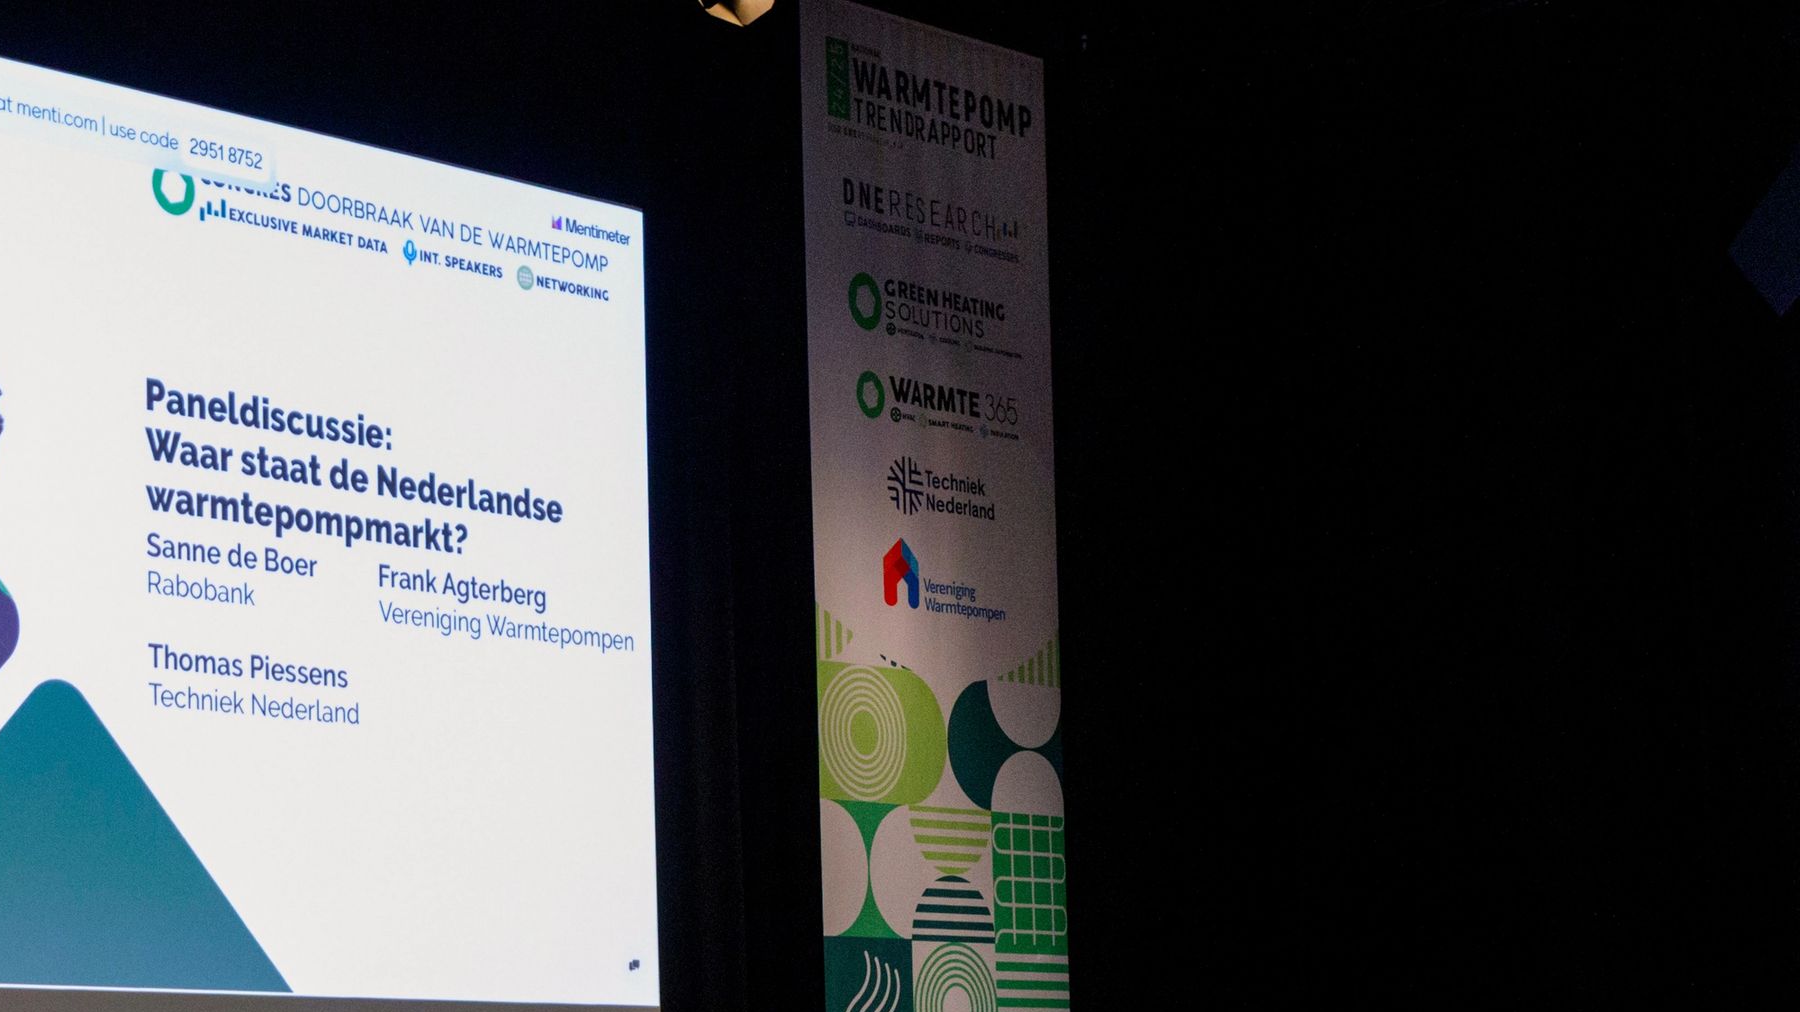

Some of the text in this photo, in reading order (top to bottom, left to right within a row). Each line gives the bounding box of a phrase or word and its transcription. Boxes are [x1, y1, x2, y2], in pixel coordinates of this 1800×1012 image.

[852, 57, 1032, 138] WARMTEPOMP
[17, 103, 98, 134] menti.com
[110, 123, 136, 141] use
[139, 128, 179, 151] code
[189, 137, 224, 161] 2951
[228, 147, 263, 169] 8752
[854, 98, 997, 160] TRENDRAPPORT
[229, 208, 388, 254] EXCLUSIVE MARKET DATA
[298, 187, 414, 230] DOORBRAAK
[419, 212, 455, 239] VAN
[460, 224, 482, 246] DE
[488, 229, 609, 273] WARMTEPOMP
[565, 217, 631, 247] Mentimeter
[419, 249, 504, 279] INT. SPEAKERS
[536, 275, 610, 302] NETWORKING
[884, 279, 1006, 321] GREEN HEATING
[885, 301, 985, 338] SOLUTIONS
[146, 378, 392, 450] Paneldiscussie:
[889, 376, 1018, 426] WARMTE 365
[145, 427, 563, 523] Waar staat de Nederlandse
[925, 470, 985, 496] Techniek
[146, 485, 468, 554] warmtepompmarkt?
[926, 494, 995, 520] Nederland
[147, 533, 317, 577] Sanne de Boer
[147, 571, 255, 606] Rabobank
[379, 564, 546, 613] Frank Agterberg
[924, 579, 976, 601] Vereniging
[924, 597, 1006, 622] Warmtepompen
[379, 601, 635, 653] Vereniging Warmtepompen
[149, 644, 348, 688] Thomas Piessens
[149, 683, 360, 724] Techniek Nederland
